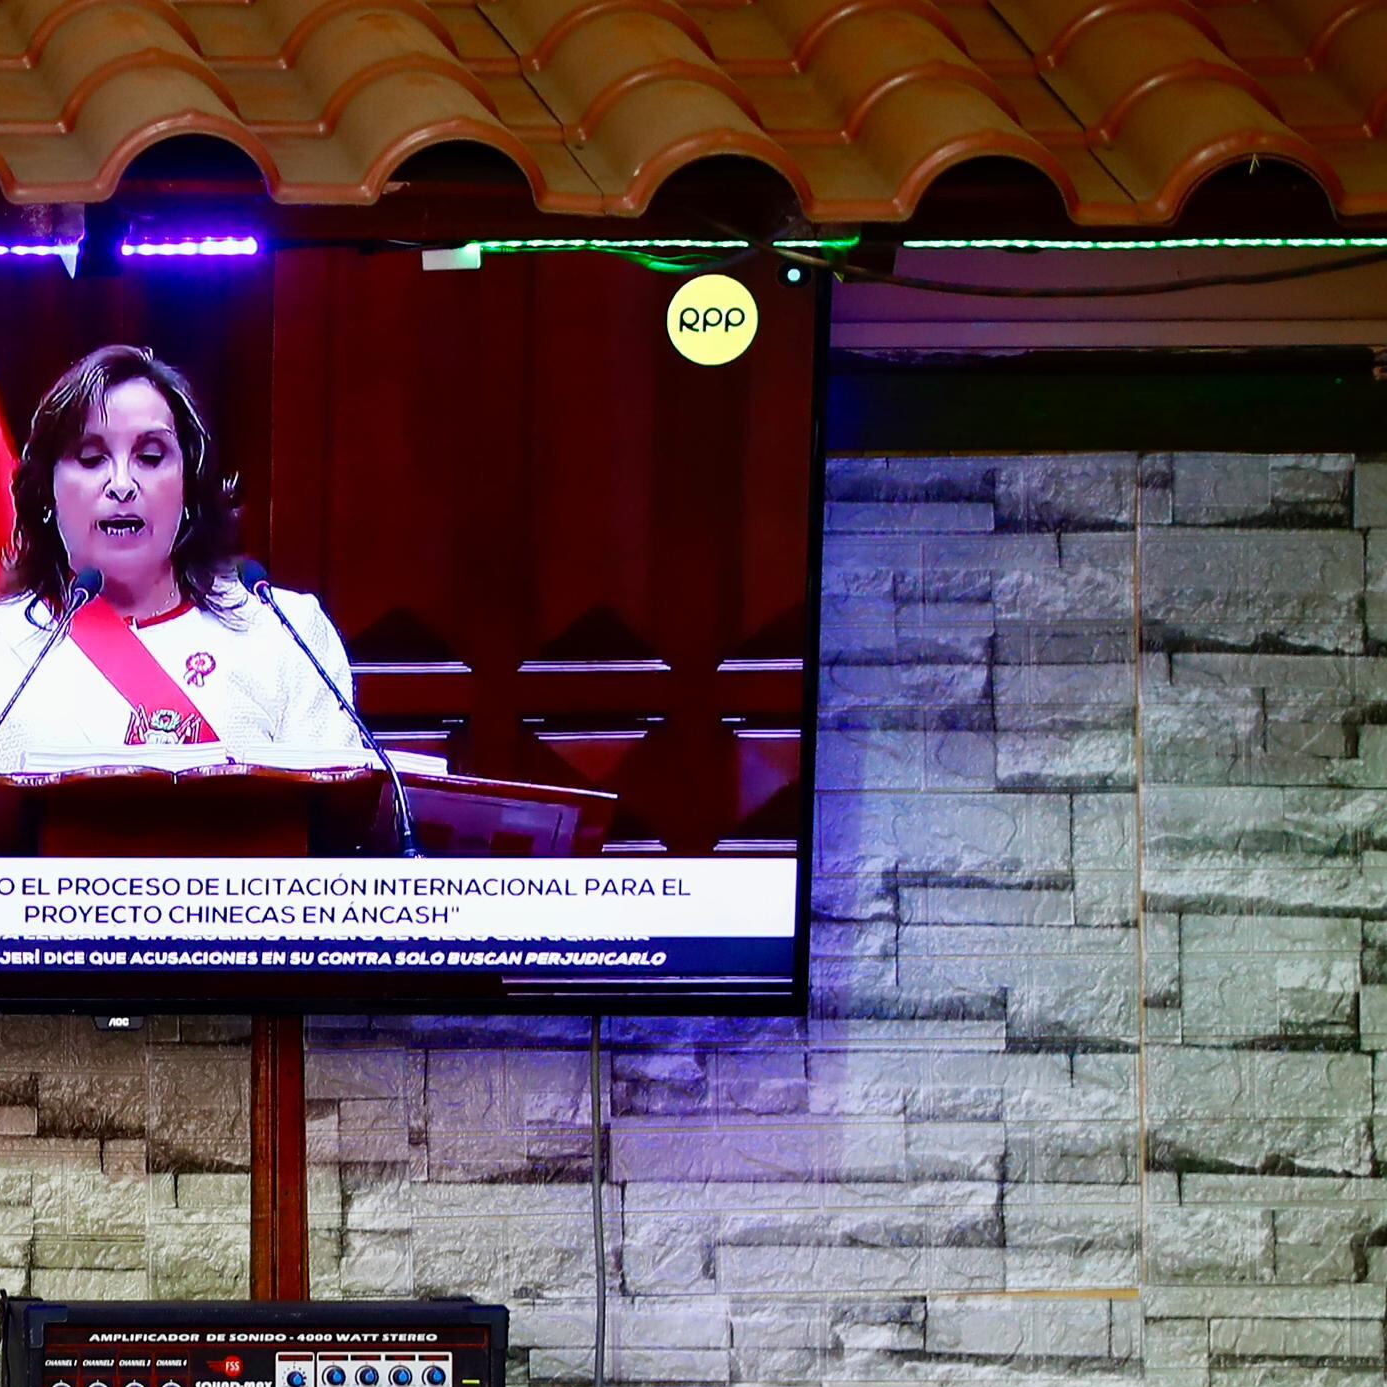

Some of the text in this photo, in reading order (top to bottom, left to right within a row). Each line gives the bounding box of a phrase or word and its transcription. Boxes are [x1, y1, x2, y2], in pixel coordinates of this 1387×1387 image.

[679, 306, 746, 333] RPP
[21, 878, 51, 896] EL
[57, 877, 181, 896] PROCESO
[187, 878, 220, 896] DE
[226, 873, 367, 897] LICITACIÓN
[374, 878, 577, 897] INTERNACIONAL
[585, 878, 655, 897] PARA
[662, 878, 691, 896] EL
[24, 901, 460, 924] PROYECTO CHINECAS EN ÁNCASH"
[43, 950, 86, 965] DICE
[88, 950, 127, 965] QUE
[129, 950, 259, 965] ACUSACIONES
[261, 951, 287, 965] EN
[289, 951, 315, 965] SU
[317, 951, 392, 965] CONTRA
[394, 951, 446, 965] SOLO
[446, 951, 523, 965] BUSCAN
[524, 951, 667, 966] PERJUDICARLO
[108, 1017, 130, 1027] AOC
[89, 1333, 200, 1342] AMPLIFICADOR
[206, 1333, 226, 1342] DE
[228, 1333, 287, 1342] SONIDO
[296, 1333, 333, 1342] 4000
[335, 1333, 380, 1342] WATT
[381, 1333, 438, 1342] STEREO
[45, 1359, 73, 1367] CHANNEL
[119, 1359, 146, 1367] CHANNEL
[156, 1359, 182, 1367] CHANNEL
